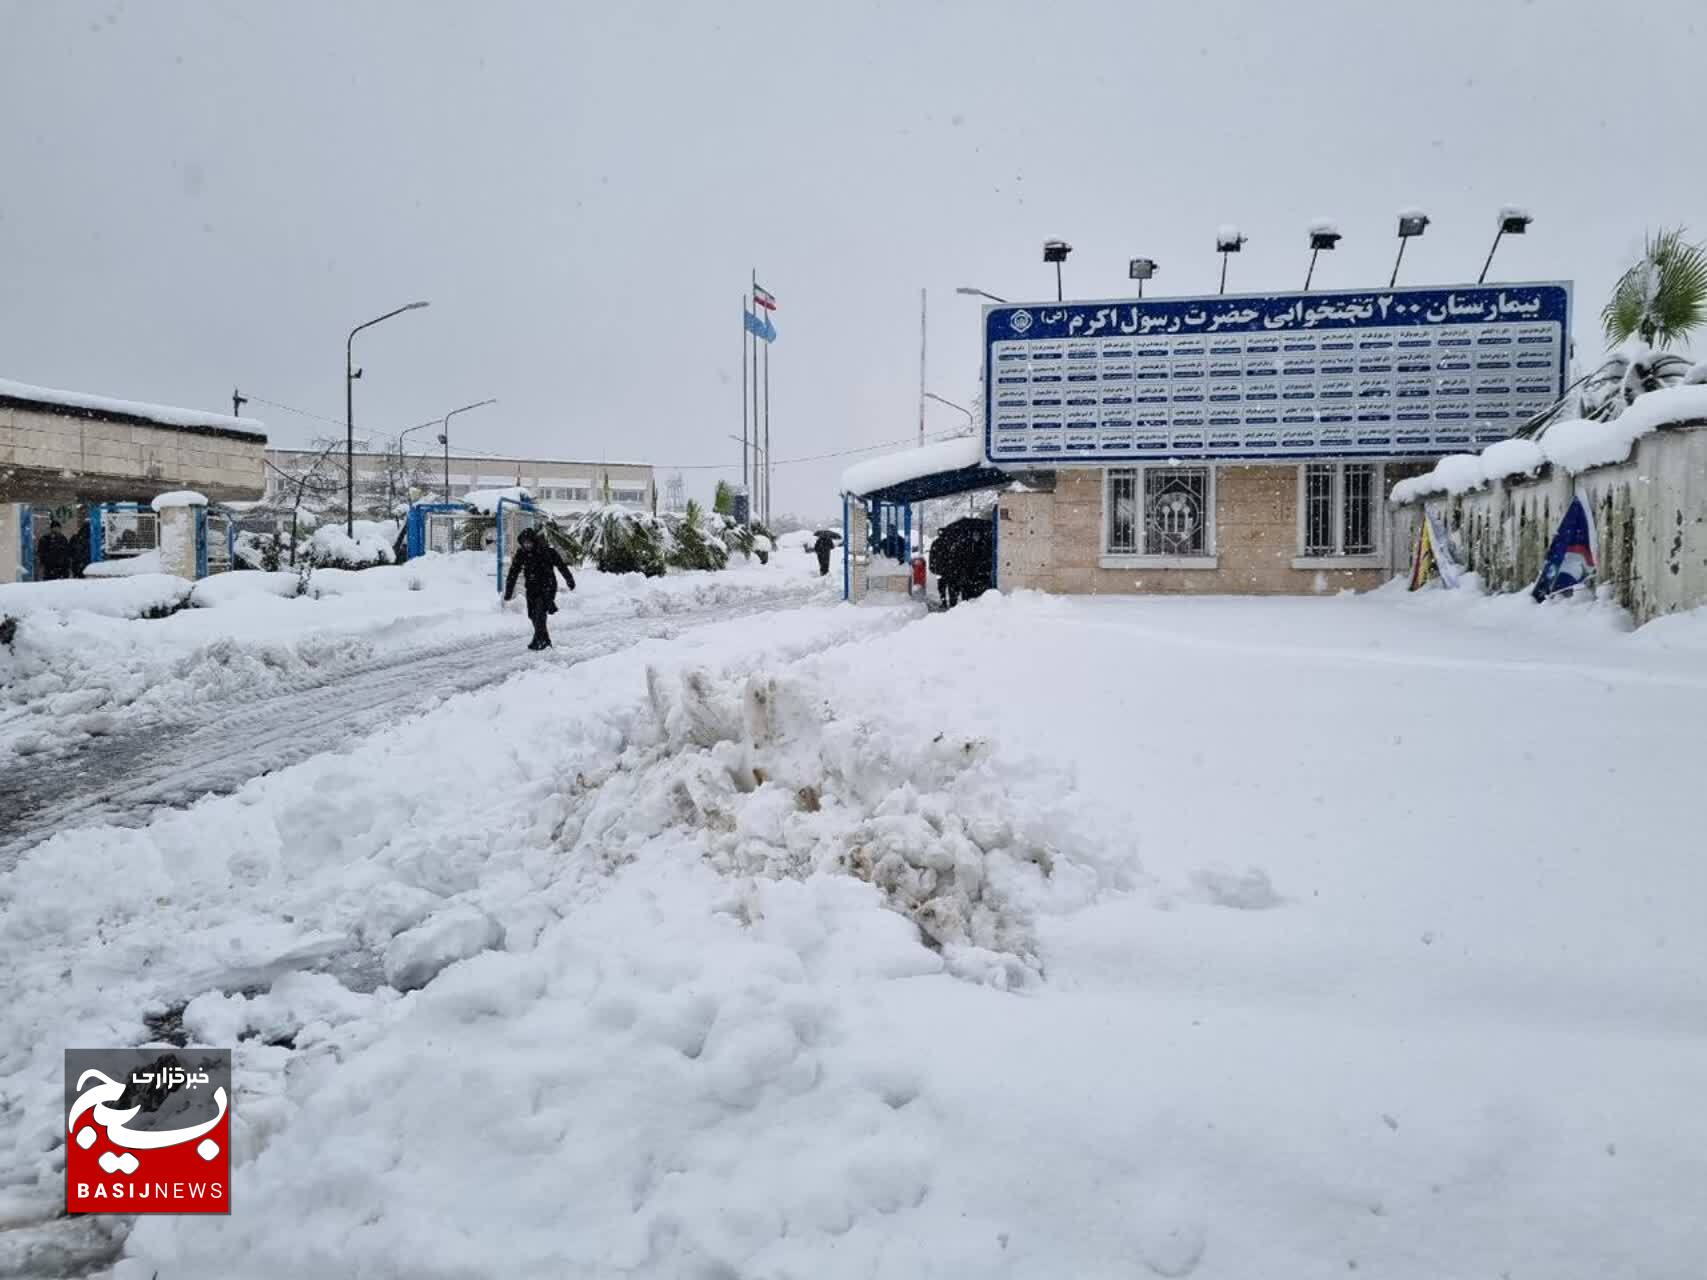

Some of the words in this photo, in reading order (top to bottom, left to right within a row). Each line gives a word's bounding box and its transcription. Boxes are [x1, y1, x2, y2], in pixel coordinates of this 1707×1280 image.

[1040, 310, 1068, 325] (ص)
[1120, 307, 1180, 334] رسول
[1184, 304, 1259, 332] حضرت
[1263, 297, 1374, 329] تختخوابی
[1379, 294, 1421, 320] ۲۰۰
[1426, 291, 1540, 323] بیمارستان
[1068, 309, 1118, 336] اکرم
